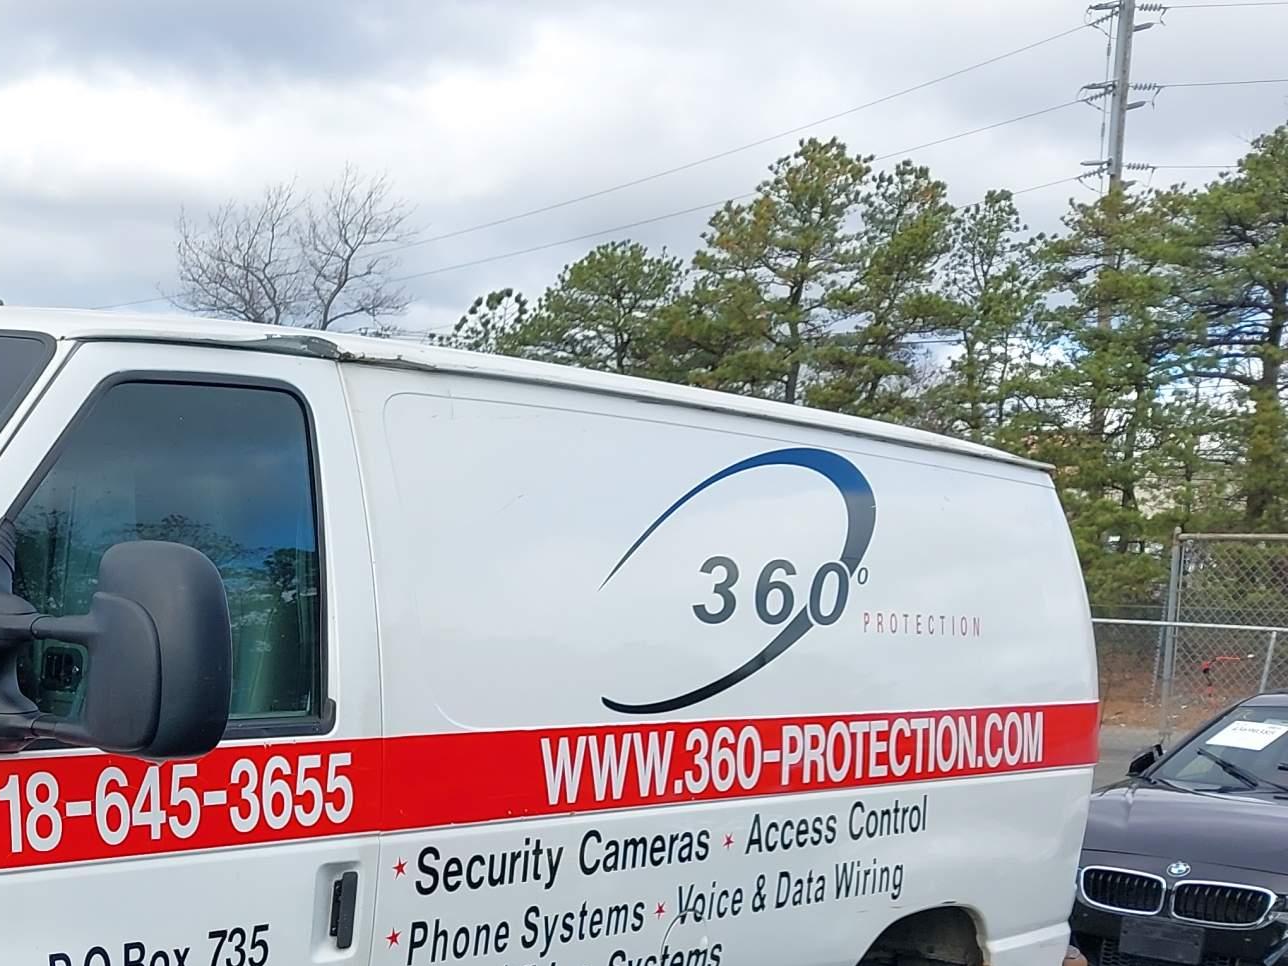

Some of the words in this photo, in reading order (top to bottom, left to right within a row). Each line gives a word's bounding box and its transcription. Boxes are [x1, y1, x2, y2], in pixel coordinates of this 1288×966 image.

[863, 611, 981, 637] PROTECTION
[540, 711, 1045, 805] WWW.360-PROTECTION.COM
[745, 813, 837, 854] Access
[848, 794, 928, 841] Control
[415, 837, 564, 895] Security
[579, 829, 710, 876] Cameras
[677, 881, 743, 925] Voice
[751, 874, 767, 913] &
[775, 869, 826, 909] Data
[834, 857, 904, 900] Wiring
[406, 918, 509, 966] Phone
[520, 900, 645, 957] Systems
